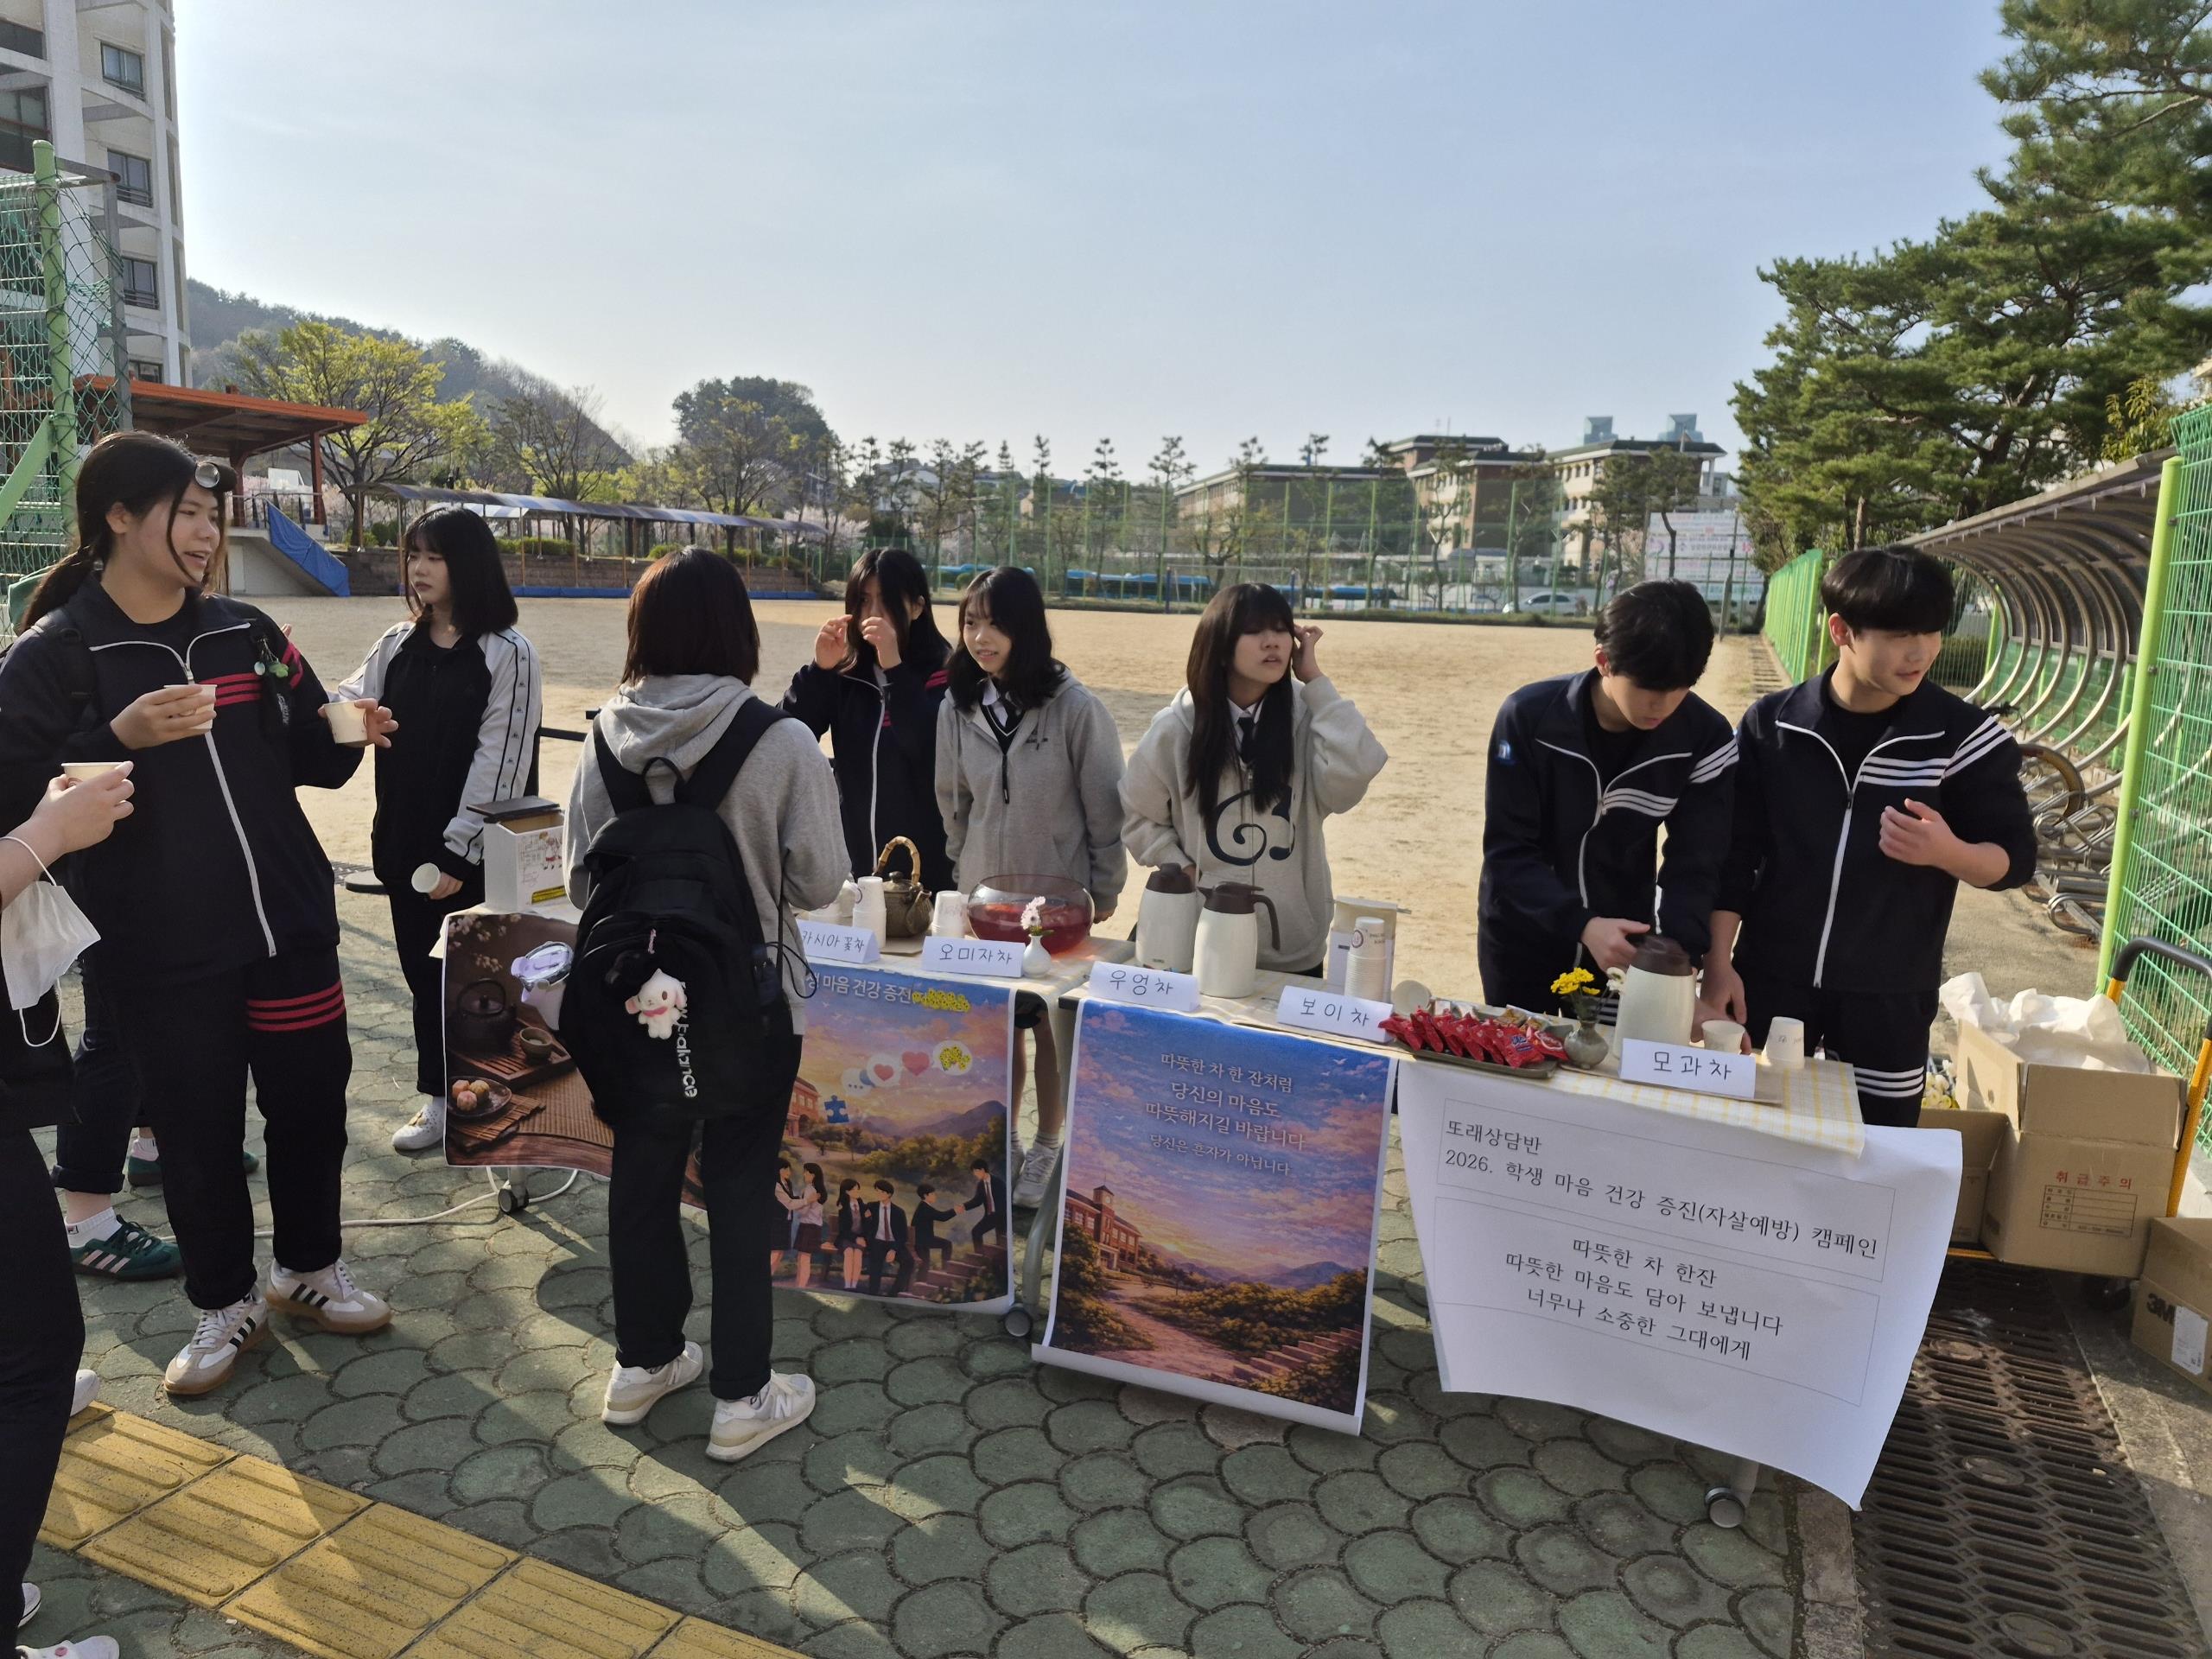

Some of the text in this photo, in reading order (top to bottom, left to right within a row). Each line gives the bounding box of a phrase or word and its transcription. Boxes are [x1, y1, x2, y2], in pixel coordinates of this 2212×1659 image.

[939, 944, 1013, 965] 오미자차
[823, 976, 850, 995] 마음
[1109, 969, 1173, 995] 우엉차
[1300, 997, 1369, 1027] 보이차
[1161, 1053, 1293, 1093] 따뜻한 차 한 잔처럼
[1654, 1052, 1732, 1080] 모과차
[1172, 1082, 1281, 1118] 당신의 마음도
[1146, 1103, 1306, 1150] 따뜻해지길 바랍니다
[1446, 1121, 1542, 1155] 또래상담반
[1150, 1134, 1189, 1153] 당신은
[1236, 1154, 1291, 1176] 아닙니다
[1446, 1149, 1877, 1260] 2026. 학생 마음 건강 증진(자살예방) 캠페인
[1573, 1239, 1718, 1288] 따뜻한 차 한잔
[1506, 1253, 1783, 1337] 따뜻한 마음도 담아 보냅니다
[1528, 1288, 1751, 1361] 너무나 소중한 그대에게
